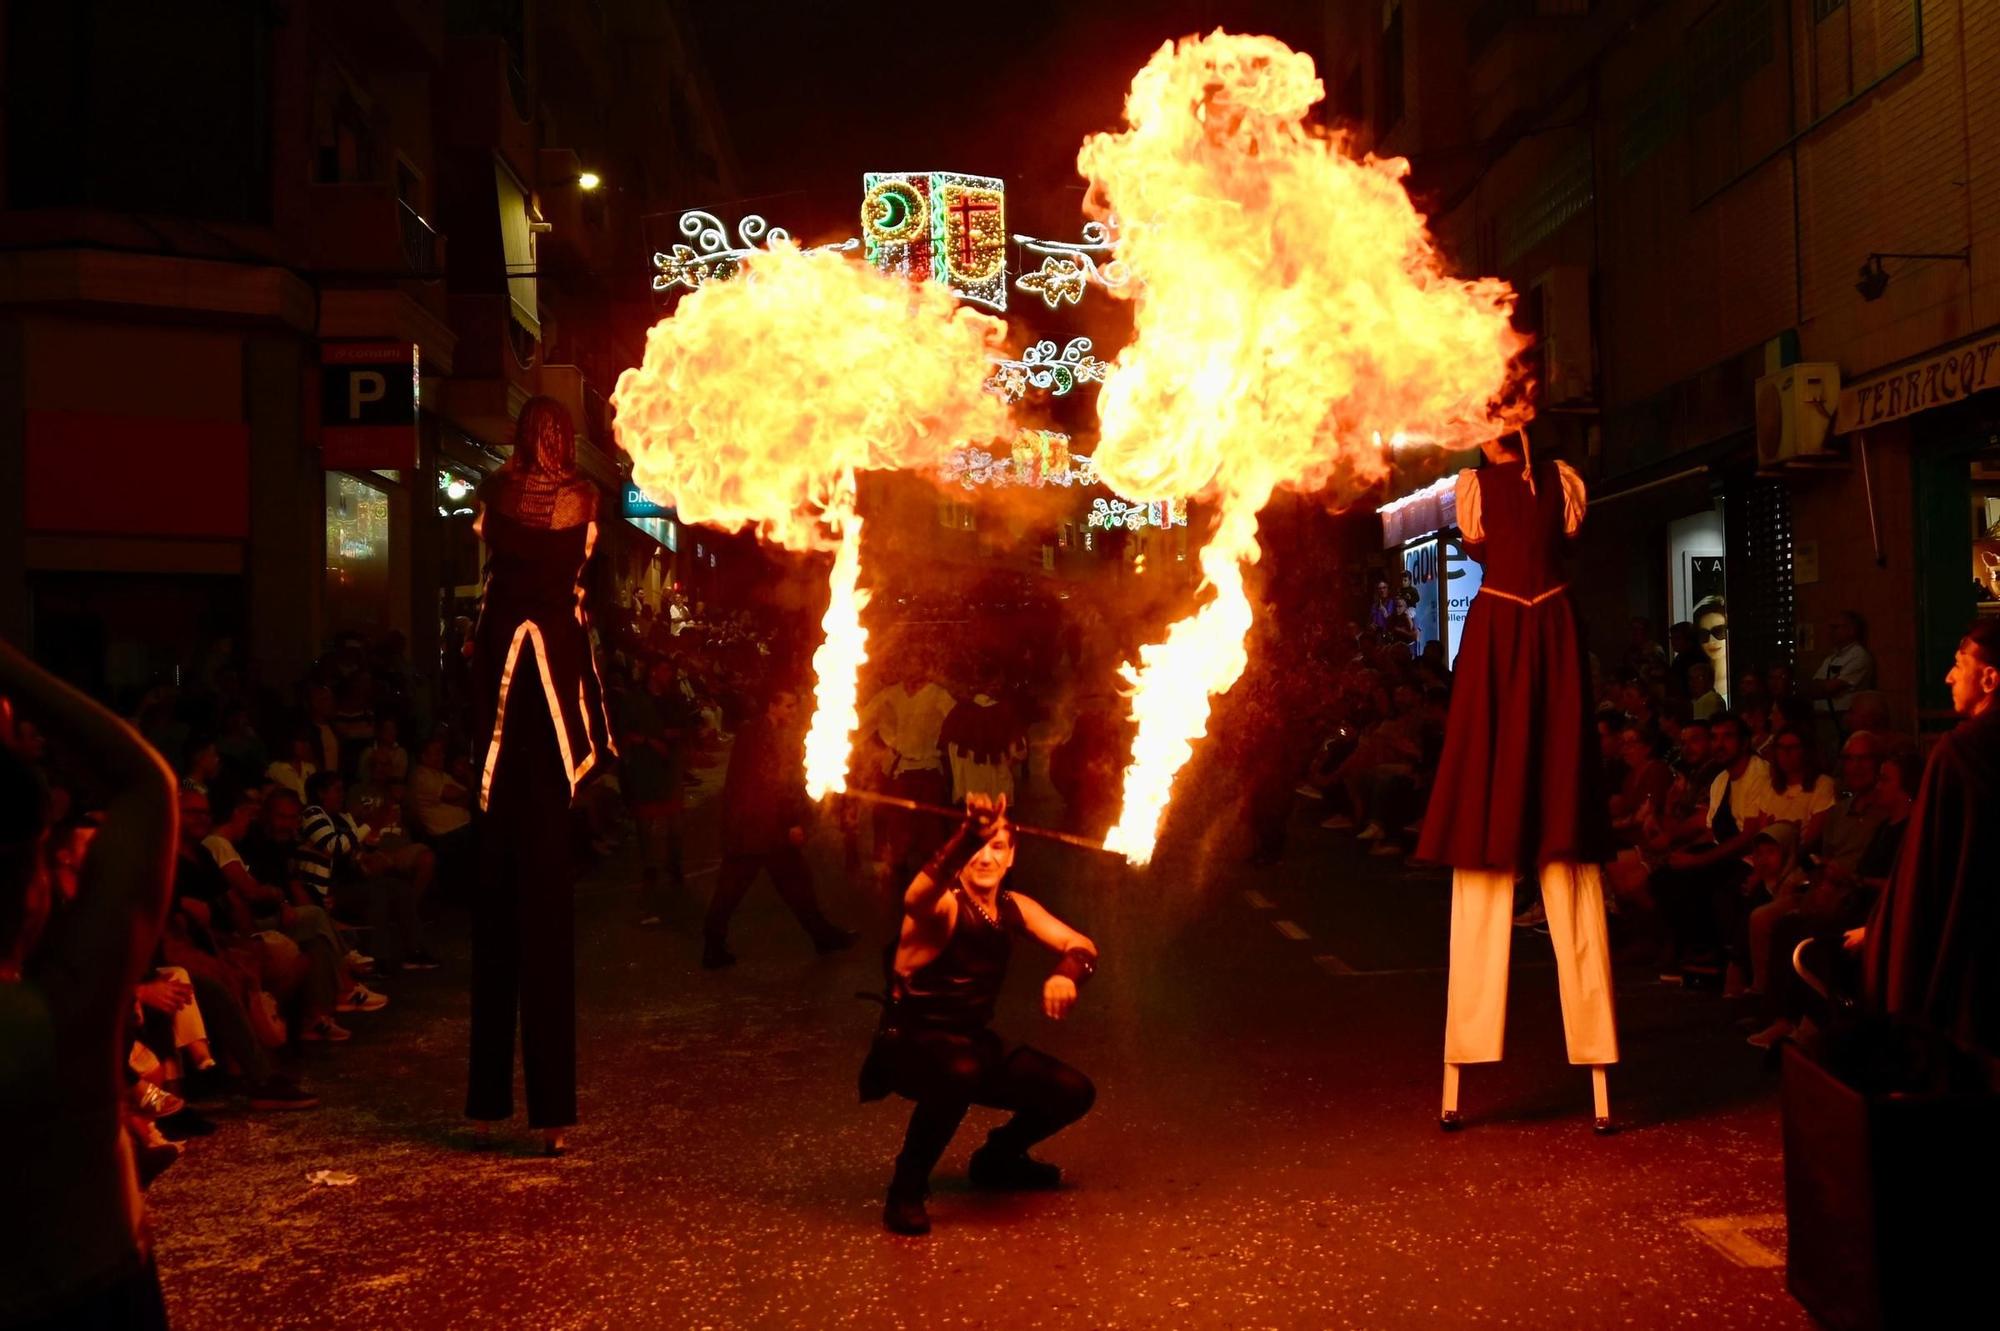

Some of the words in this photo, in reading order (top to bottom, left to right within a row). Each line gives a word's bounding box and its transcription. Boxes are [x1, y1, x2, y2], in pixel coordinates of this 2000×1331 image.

[349, 370, 386, 419] P
[1856, 341, 2000, 425] TERRACOT
[628, 490, 652, 503] DR
